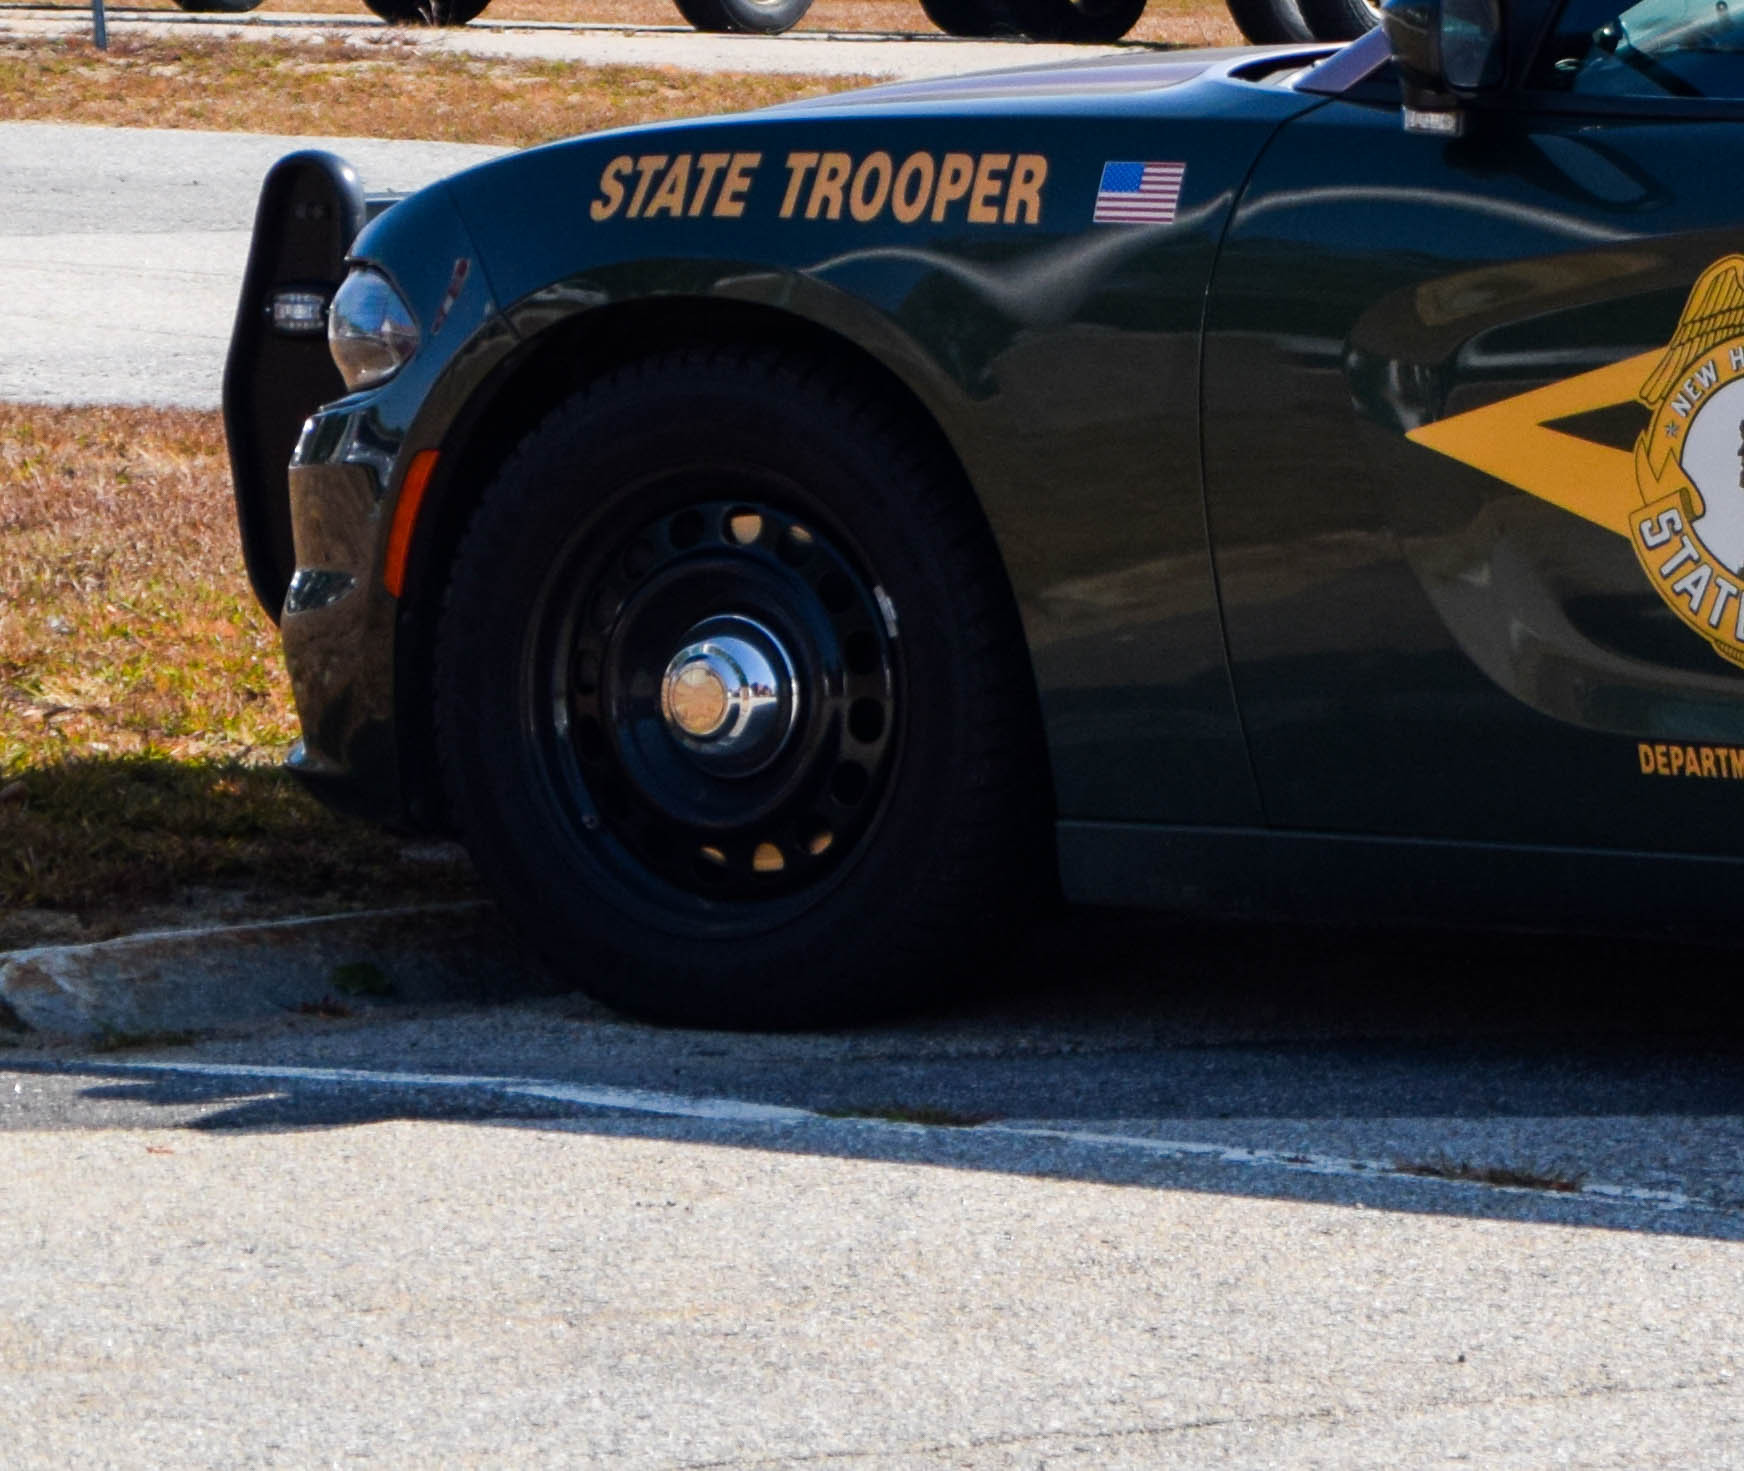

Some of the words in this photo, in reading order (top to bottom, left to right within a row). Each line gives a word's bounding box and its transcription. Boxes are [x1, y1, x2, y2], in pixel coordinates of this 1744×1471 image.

[590, 153, 762, 221] STATE
[779, 151, 1048, 224] TROOPER
[1671, 359, 1719, 420] NEW
